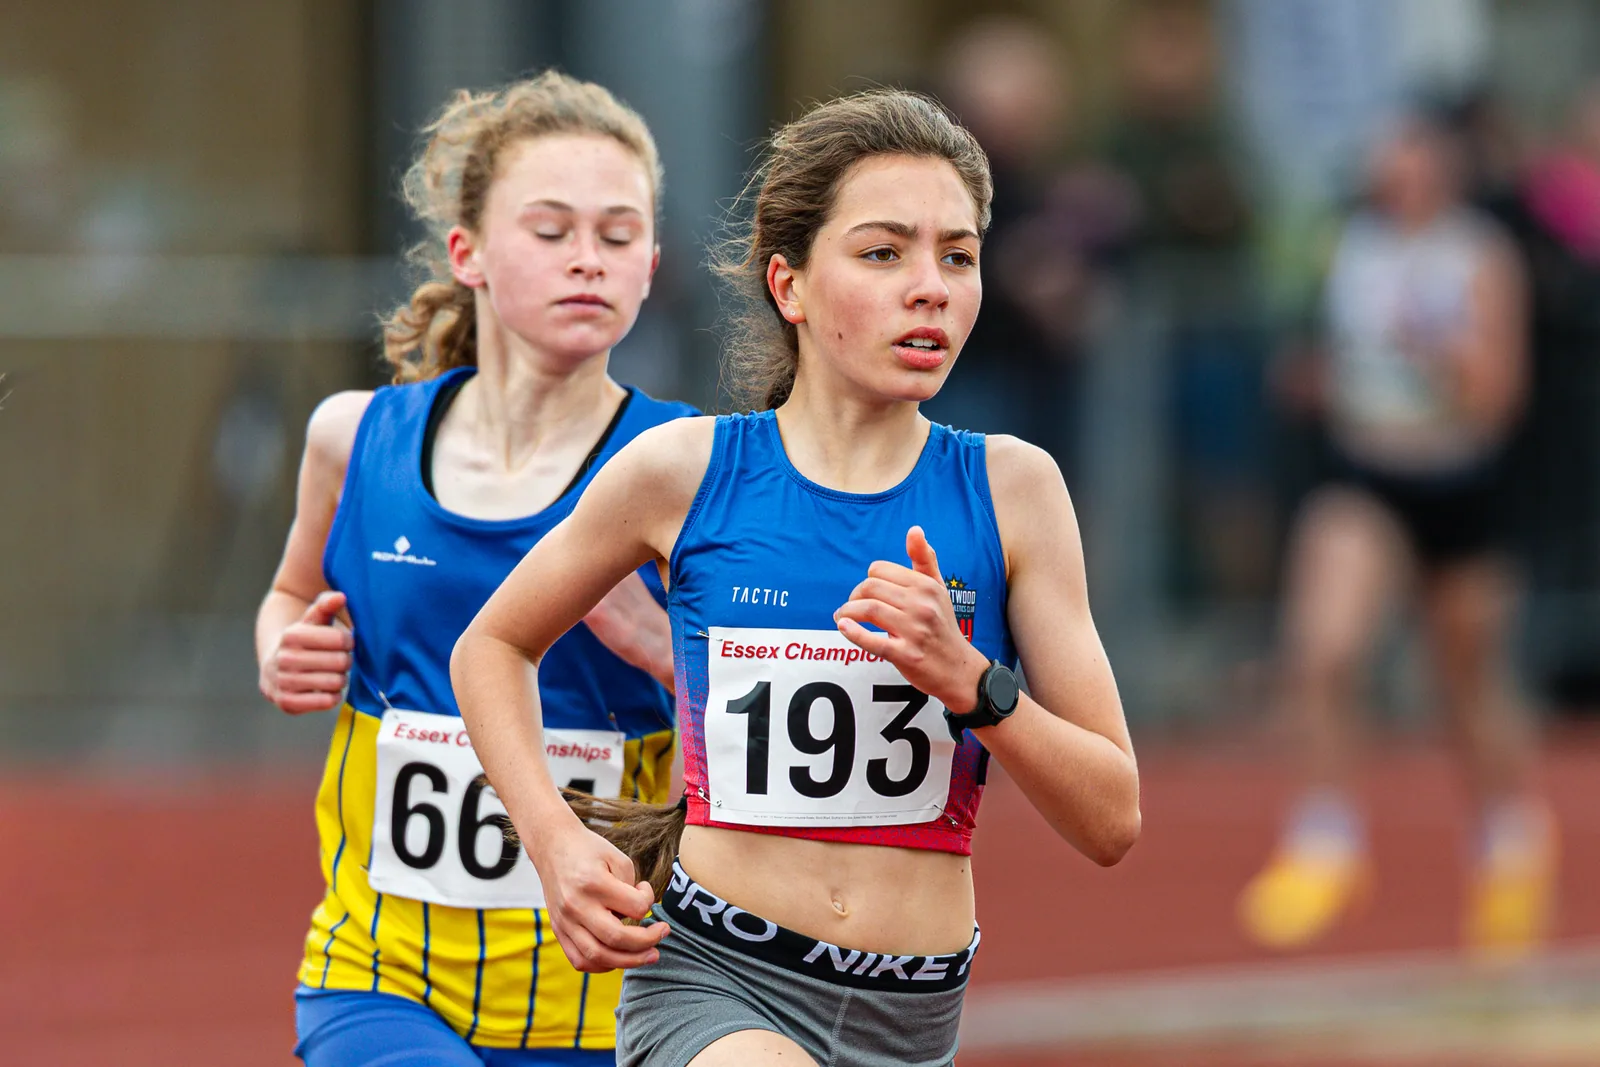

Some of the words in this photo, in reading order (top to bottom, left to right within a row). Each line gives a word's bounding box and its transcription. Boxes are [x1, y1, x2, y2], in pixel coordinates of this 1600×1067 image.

[732, 586, 789, 607] TACTIC
[721, 641, 780, 659] Essex
[784, 643, 887, 666] Champio
[394, 723, 453, 745] Essex
[725, 680, 931, 799] 193
[391, 761, 596, 880] 66
[667, 861, 778, 942] PRO
[803, 941, 958, 981] NIKE
